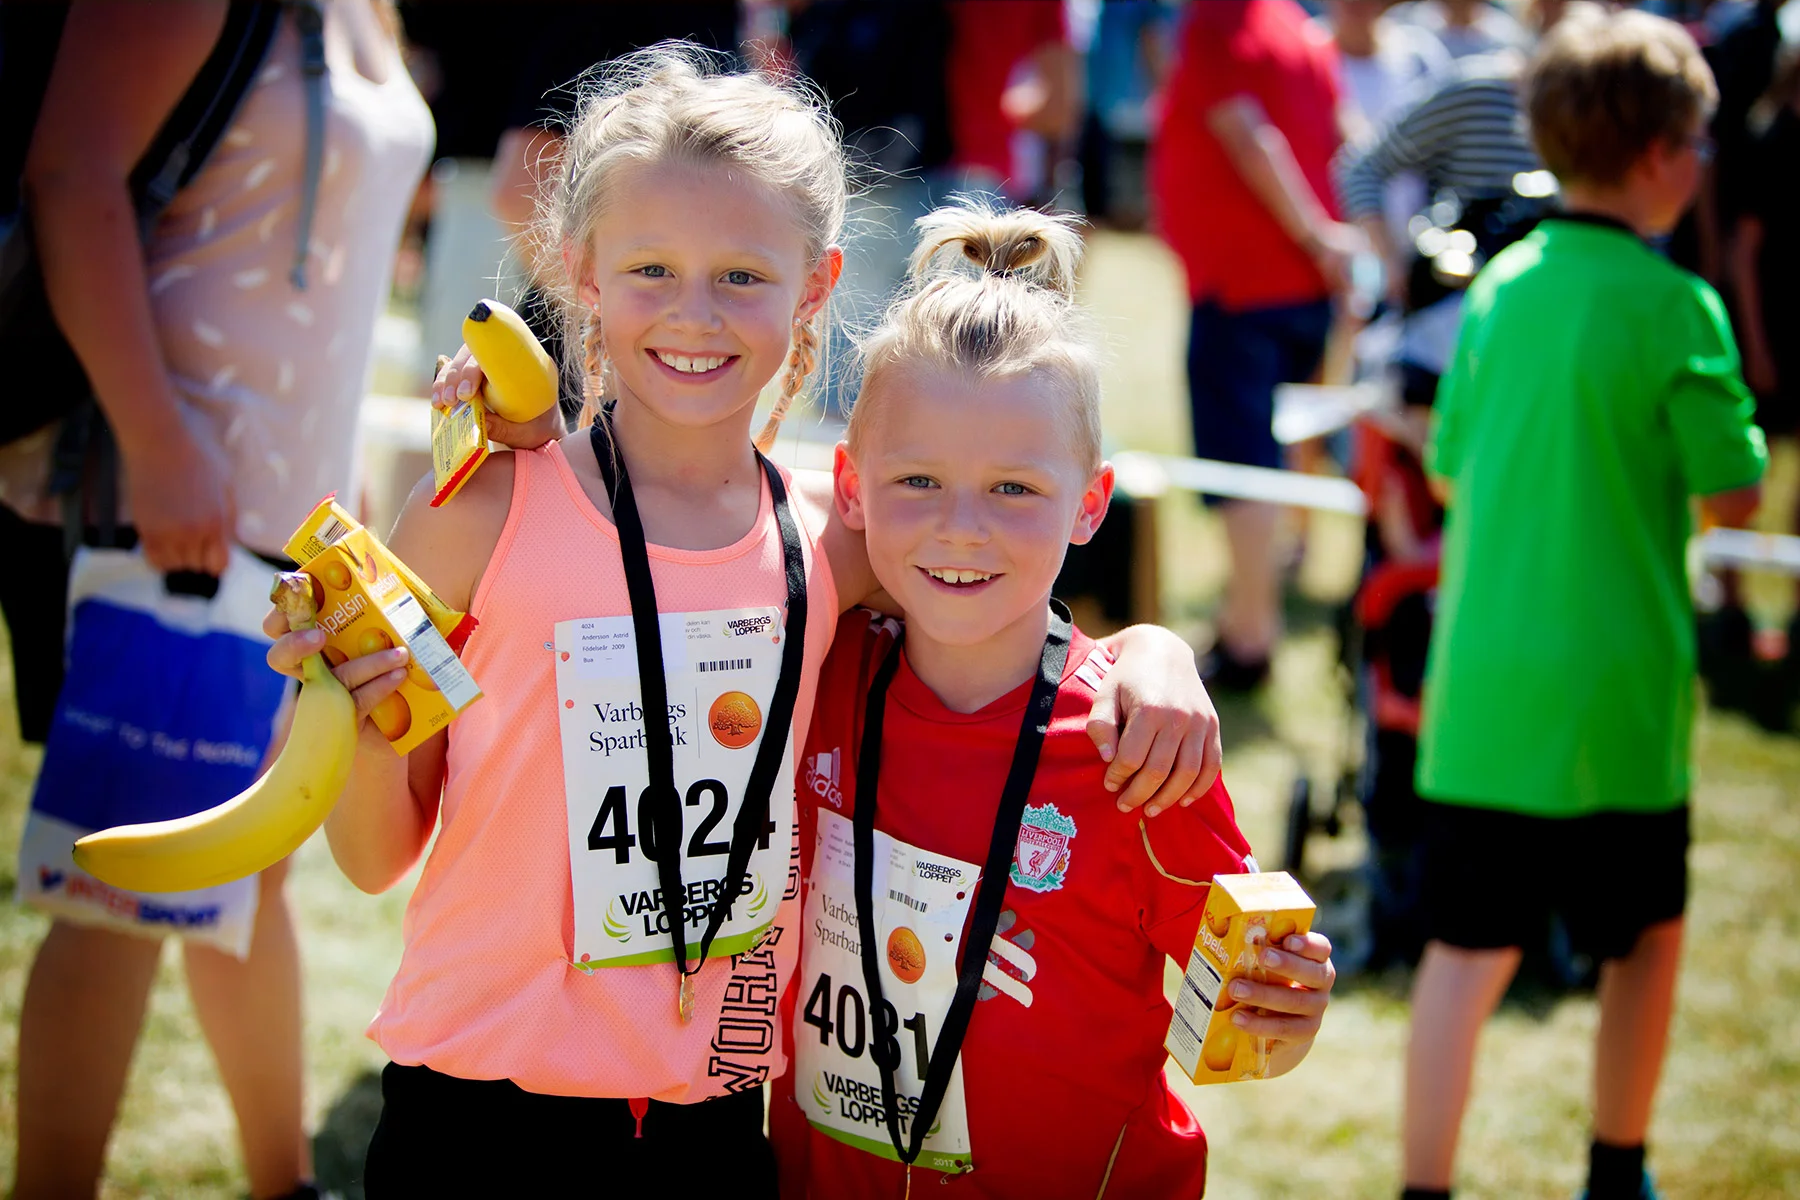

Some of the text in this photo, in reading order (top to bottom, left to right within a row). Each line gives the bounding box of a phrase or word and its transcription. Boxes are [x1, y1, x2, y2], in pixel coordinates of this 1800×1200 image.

[315, 593, 369, 636] Apelsin
[727, 615, 772, 630] VARBERGS
[581, 633, 610, 641] Andersson
[734, 625, 766, 637] LOPPET
[592, 701, 687, 725] Varbgs
[589, 730, 688, 757] Sparbk
[805, 767, 843, 808] adidas
[1021, 829, 1062, 847] LIVERPOOL
[915, 859, 962, 878] VARBERGS
[919, 869, 954, 884] LOPPET
[821, 893, 860, 929] Varber
[813, 918, 863, 958] Sparban
[1197, 924, 1231, 969] Apelsin
[803, 971, 930, 1082] 4031
[823, 1070, 922, 1117] VARBEGS
[839, 1097, 911, 1135] LOPPT
[933, 1157, 955, 1168] 2017
